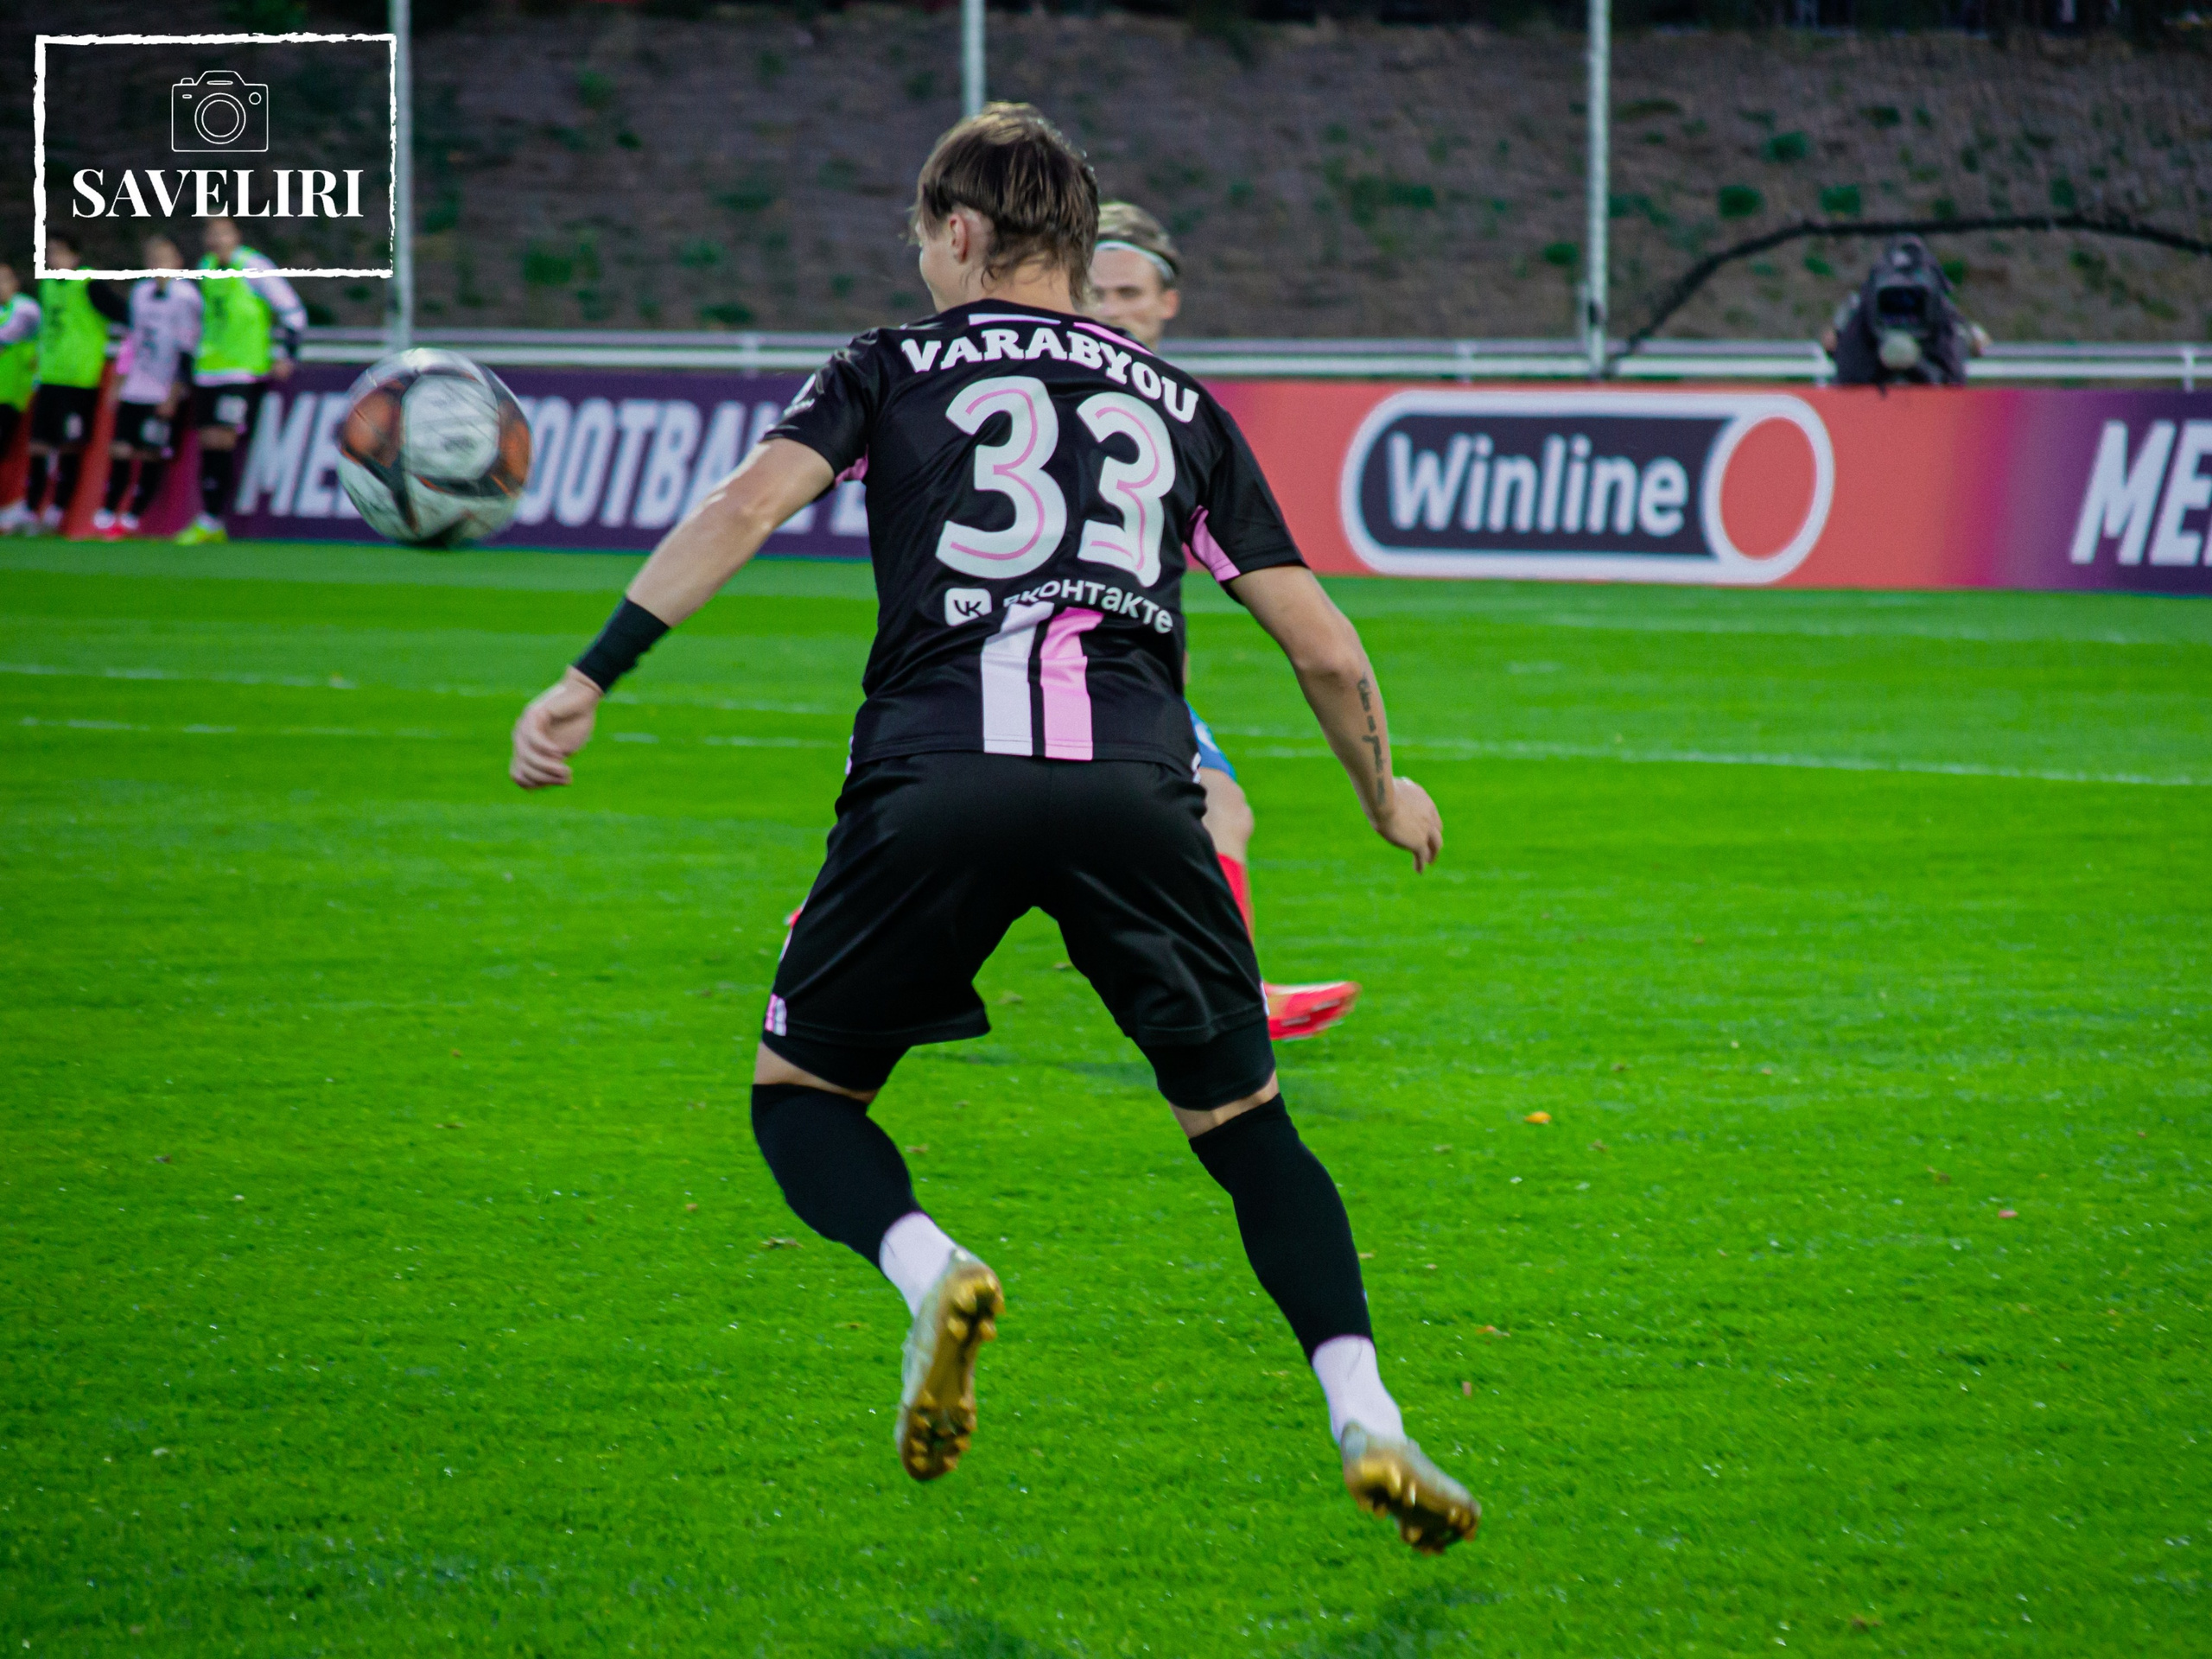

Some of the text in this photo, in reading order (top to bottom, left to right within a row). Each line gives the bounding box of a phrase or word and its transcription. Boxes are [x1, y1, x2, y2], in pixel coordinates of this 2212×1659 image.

[901, 327, 1198, 423] VARABYOU
[235, 391, 364, 516] ME
[936, 376, 1176, 588] 33
[1388, 431, 1689, 537] Winline
[2071, 418, 2212, 566] ME
